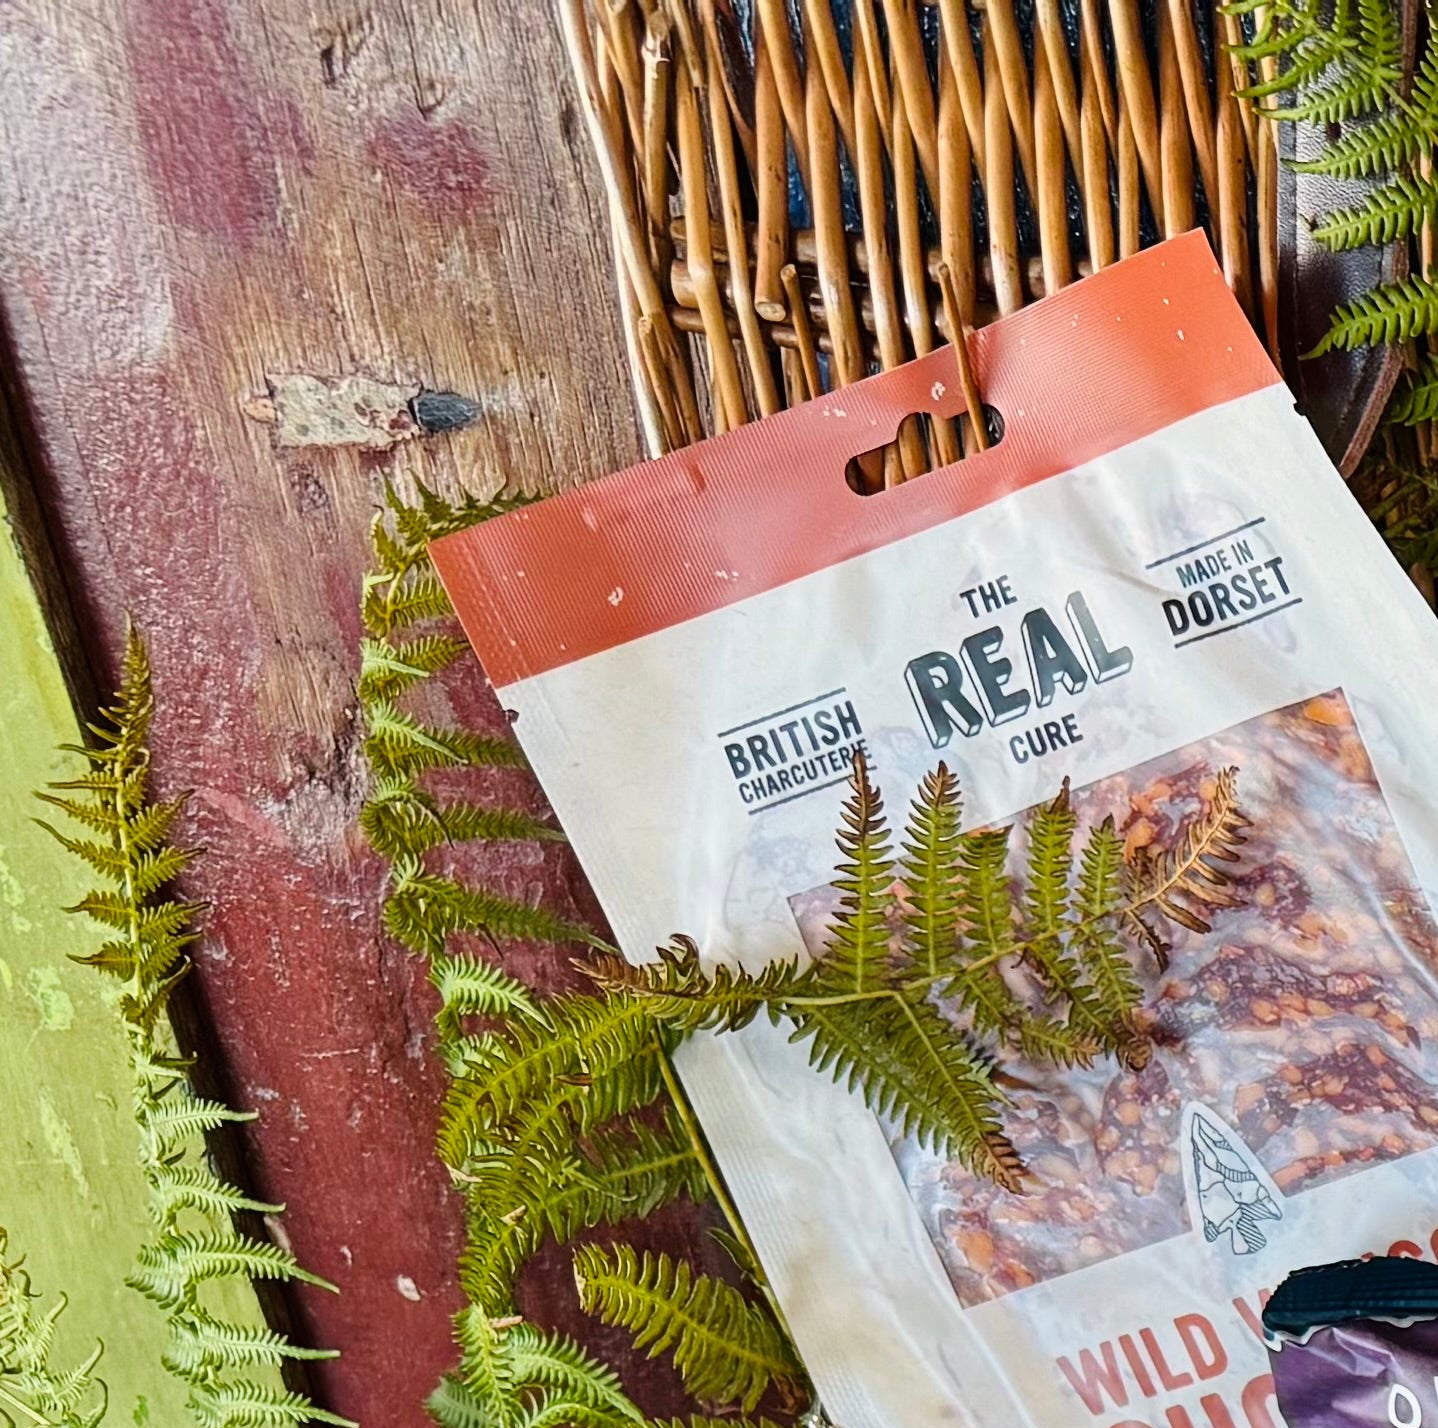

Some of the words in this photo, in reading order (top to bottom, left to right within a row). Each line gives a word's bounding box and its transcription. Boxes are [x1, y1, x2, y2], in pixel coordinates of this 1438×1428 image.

[1162, 558, 1295, 636] DORSET
[1176, 549, 1229, 589] MADE
[1231, 539, 1254, 568] IN
[725, 701, 862, 779] BRITISH
